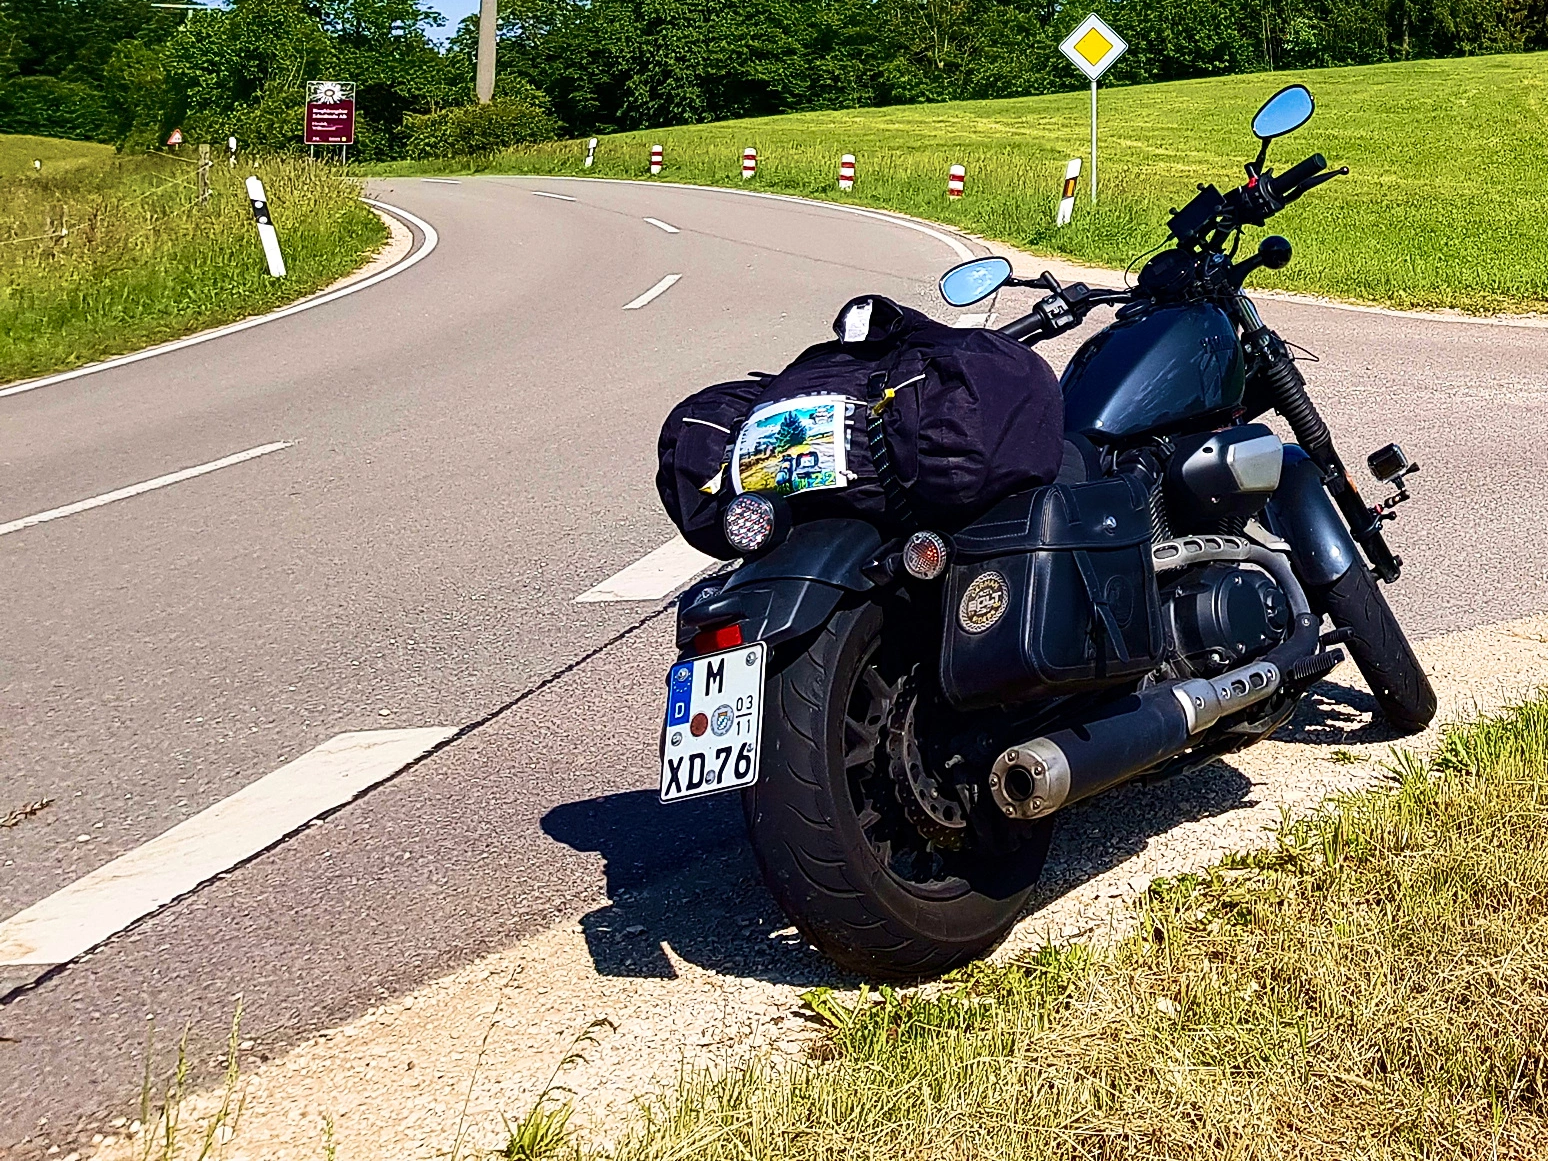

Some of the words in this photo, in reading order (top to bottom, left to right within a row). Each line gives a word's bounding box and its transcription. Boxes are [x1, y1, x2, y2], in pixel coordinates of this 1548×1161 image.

[705, 657, 725, 697] M
[674, 702, 685, 719] D
[735, 694, 754, 712] 03
[736, 719, 751, 736] 11
